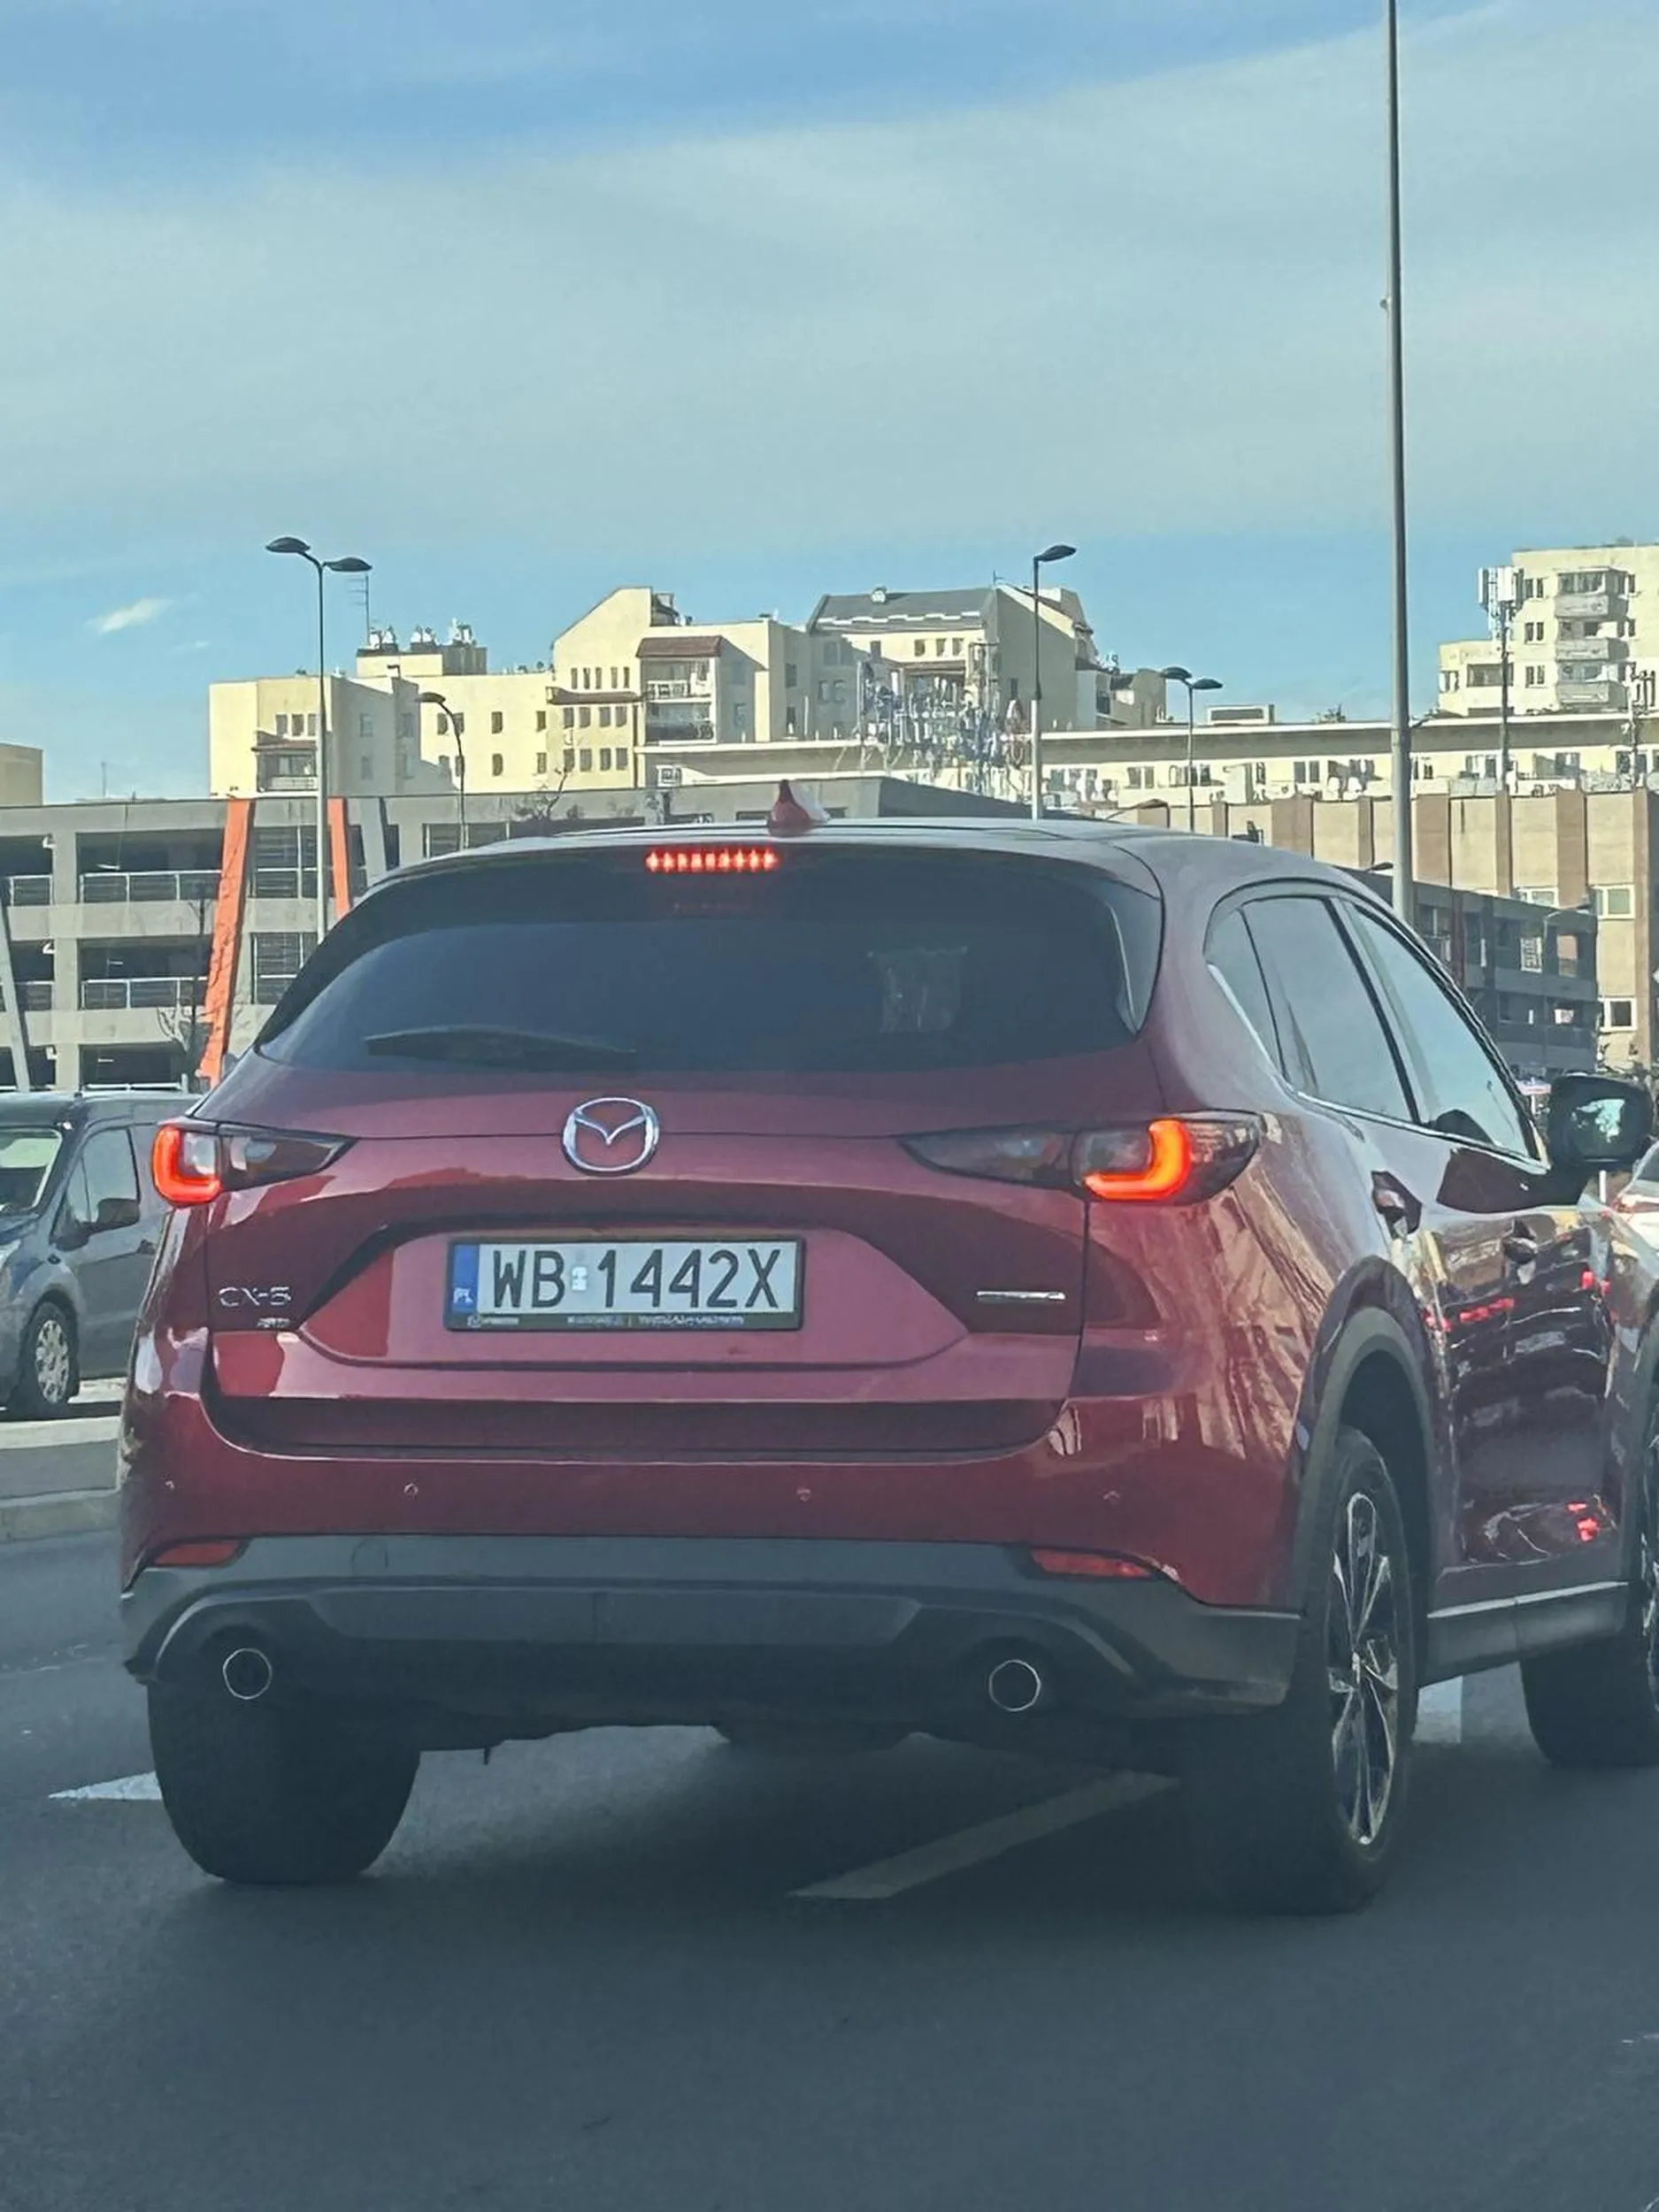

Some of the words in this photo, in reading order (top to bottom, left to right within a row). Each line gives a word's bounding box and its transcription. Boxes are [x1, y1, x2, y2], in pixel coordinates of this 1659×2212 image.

[219, 1286, 292, 1307] CX-5
[493, 1249, 565, 1308] WB
[597, 1248, 780, 1308] 1442X
